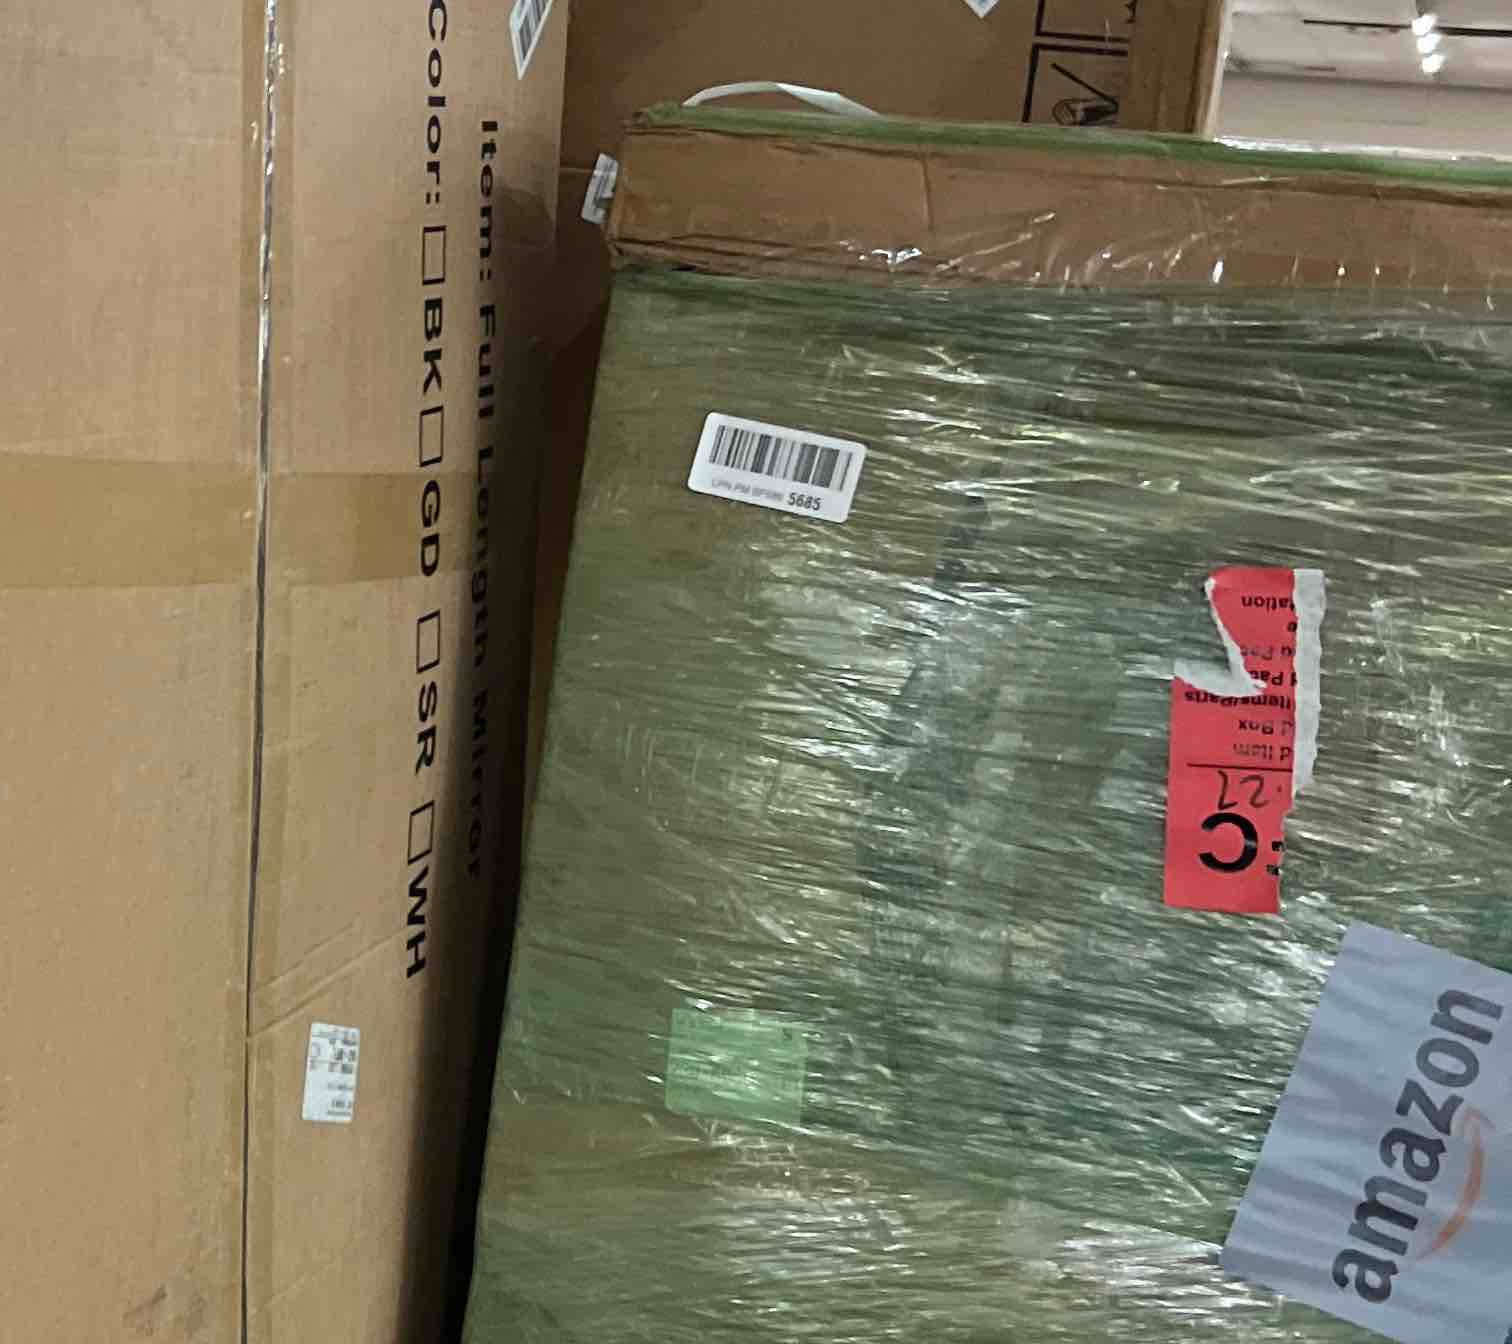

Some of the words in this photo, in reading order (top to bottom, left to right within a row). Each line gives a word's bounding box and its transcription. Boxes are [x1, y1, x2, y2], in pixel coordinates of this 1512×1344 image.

[479, 121, 498, 280] Item:
[422, 297, 444, 394] BK
[478, 305, 496, 420] Full
[418, 481, 440, 577] GD
[471, 448, 494, 664] Length
[415, 681, 438, 774] SR
[1199, 812, 1259, 873] C
[406, 866, 428, 978] WH
[1333, 988, 1504, 1306] amazon
